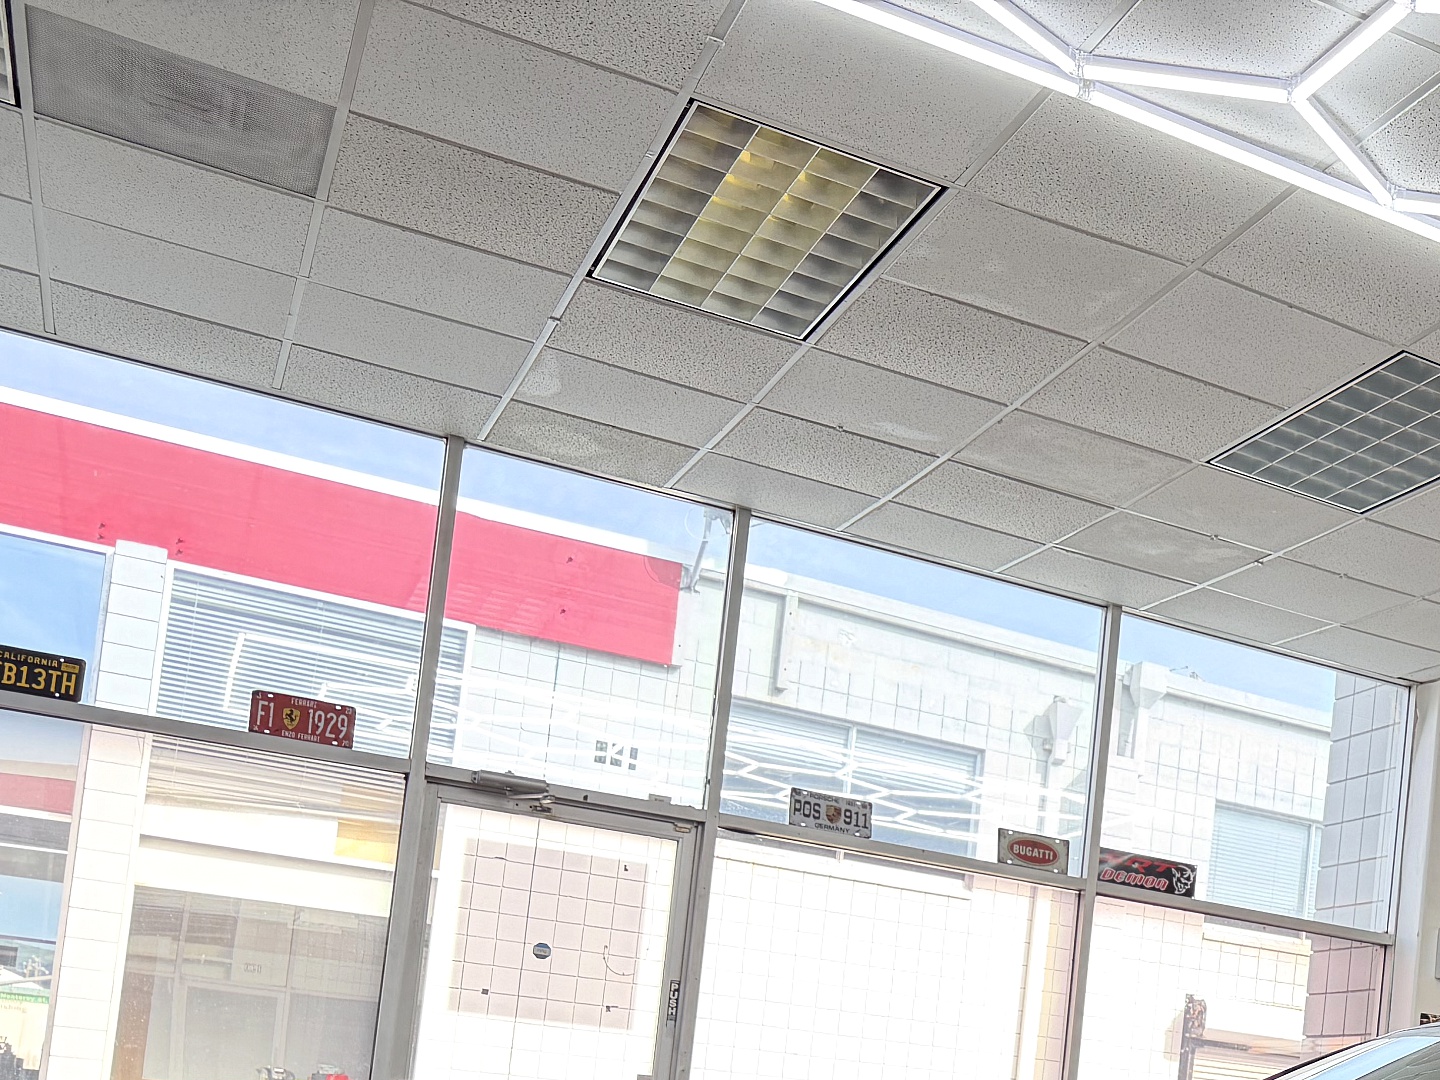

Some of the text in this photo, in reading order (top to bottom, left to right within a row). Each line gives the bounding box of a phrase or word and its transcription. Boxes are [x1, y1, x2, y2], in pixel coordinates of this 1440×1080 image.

[0, 661, 77, 695] B13TH
[256, 700, 348, 739] F1 1929
[843, 808, 869, 830] 911
[1012, 843, 1053, 861] BUGATTI
[667, 982, 680, 1016] PUSH
